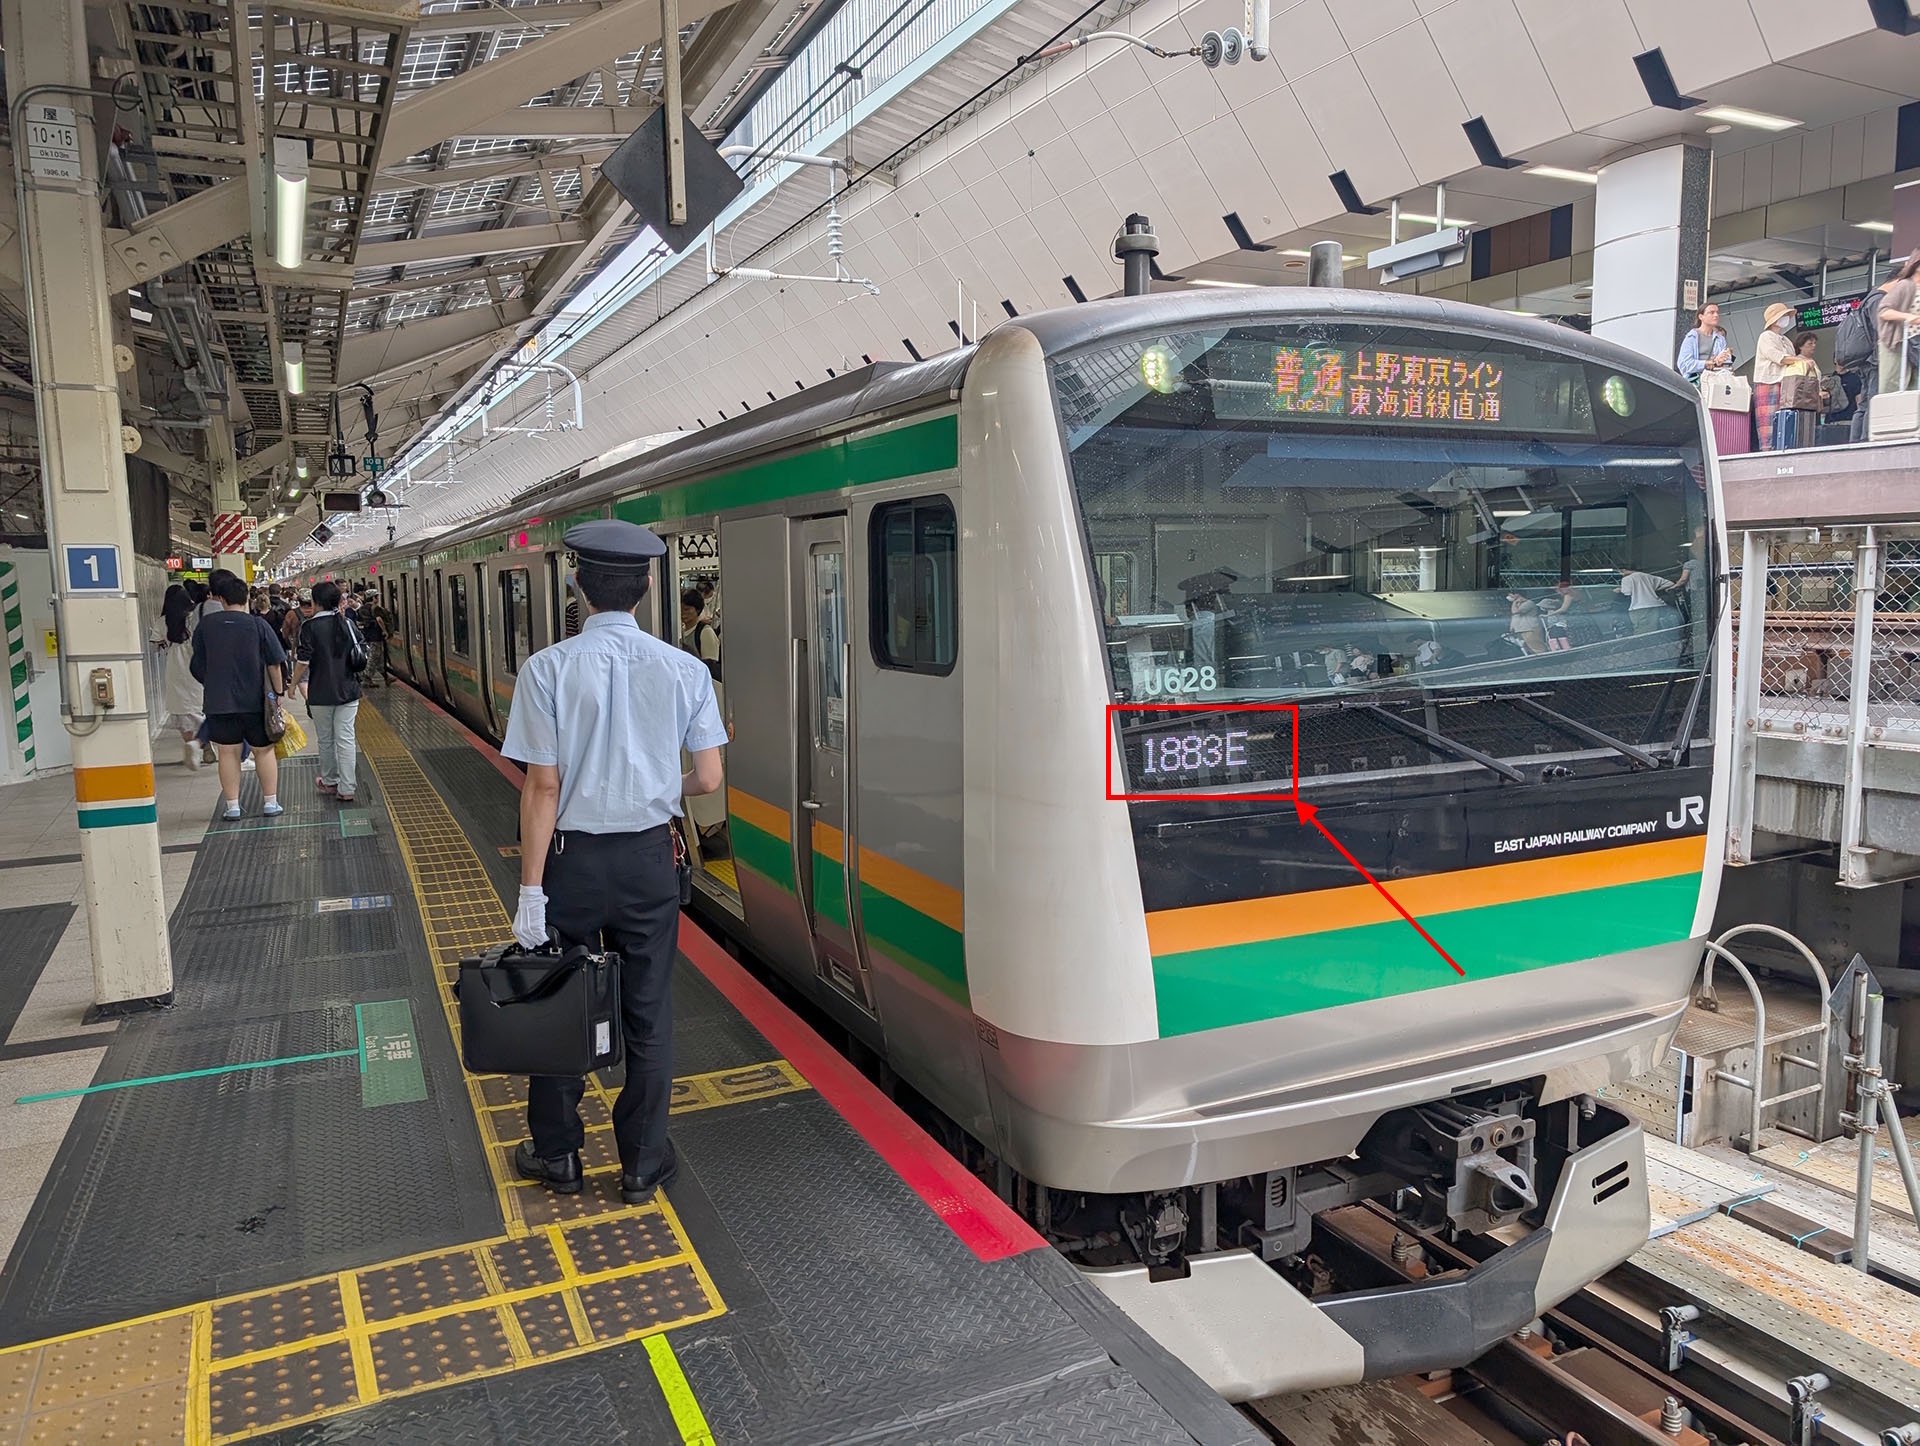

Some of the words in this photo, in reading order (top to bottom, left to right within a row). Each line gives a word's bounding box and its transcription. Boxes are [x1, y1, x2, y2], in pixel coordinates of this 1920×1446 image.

[1275, 349, 1343, 397] 普通
[1349, 351, 1502, 388] 上野東京ライン
[1286, 397, 1330, 412] Local
[1349, 385, 1501, 421] 東海道線直通
[83, 555, 99, 581] 1
[1144, 665, 1217, 695] U628
[1144, 730, 1248, 773] 1883E
[1666, 795, 1704, 829] JR
[1495, 838, 1525, 853] EAST
[1525, 833, 1562, 849] JAPAN
[1563, 827, 1607, 843] RAILWAY
[1607, 820, 1658, 838] COMPANY
